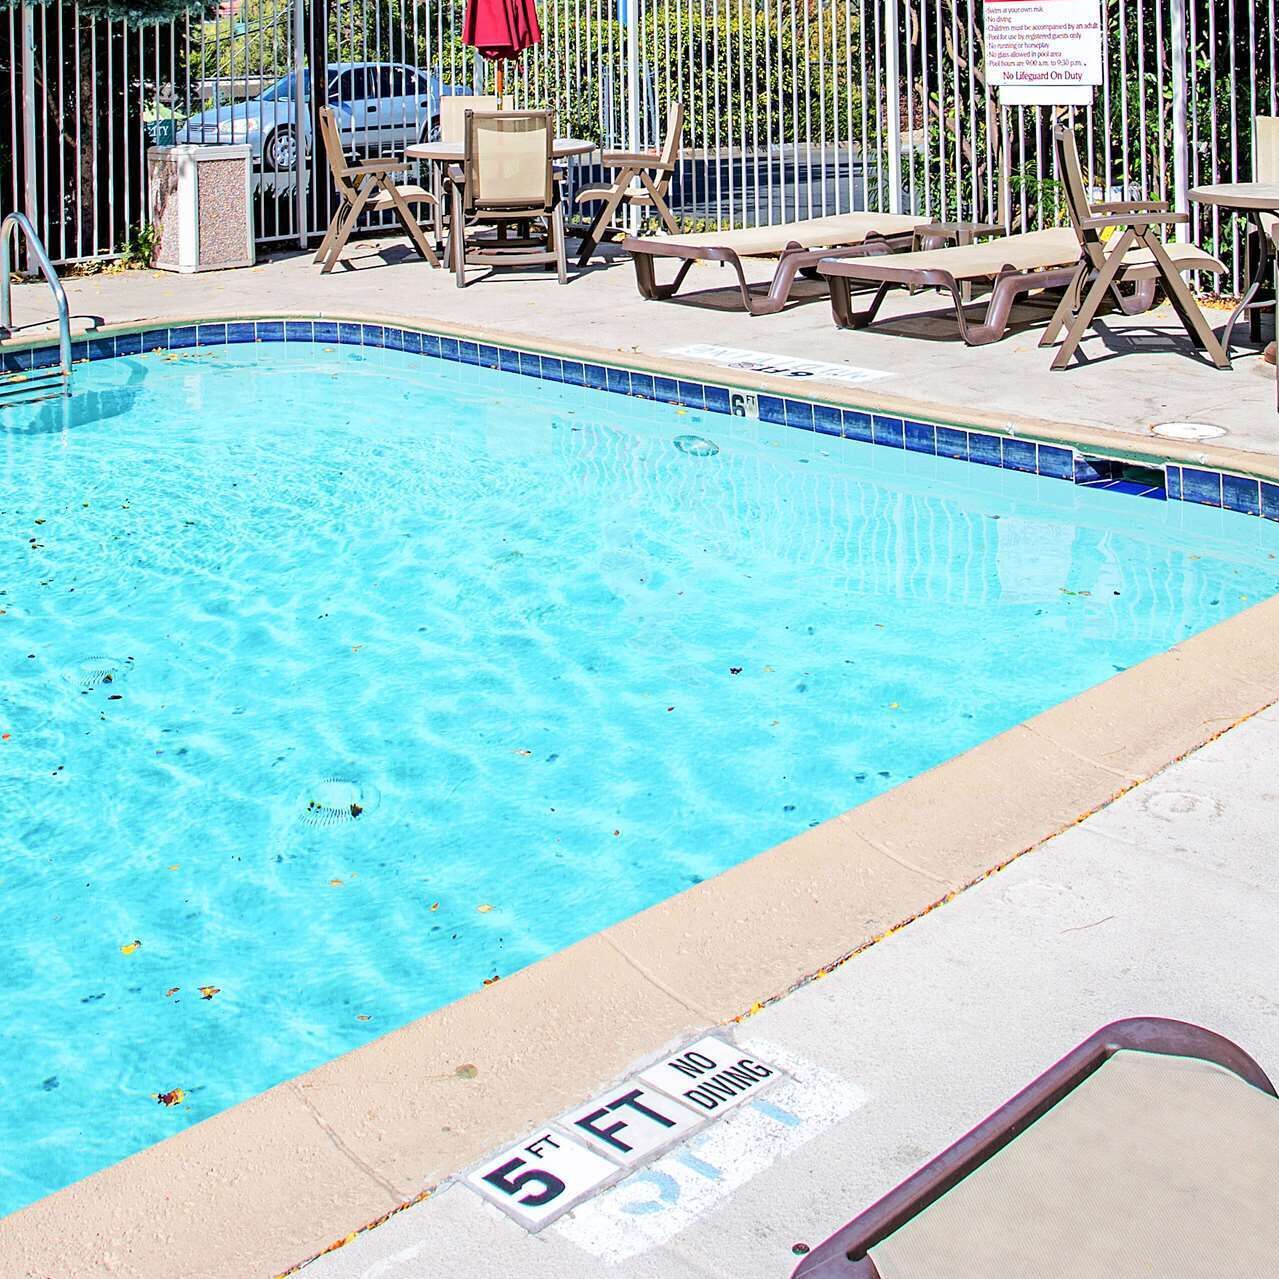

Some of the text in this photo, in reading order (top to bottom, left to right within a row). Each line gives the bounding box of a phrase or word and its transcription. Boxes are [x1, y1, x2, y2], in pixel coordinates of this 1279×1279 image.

[1003, 70, 1083, 82] No Lifeguard On Duty
[732, 394, 756, 418] 6 FT
[668, 1051, 718, 1080] NO
[682, 1058, 775, 1111] DIVING
[574, 1088, 678, 1153] FT
[481, 1134, 566, 1208] 5 FT
